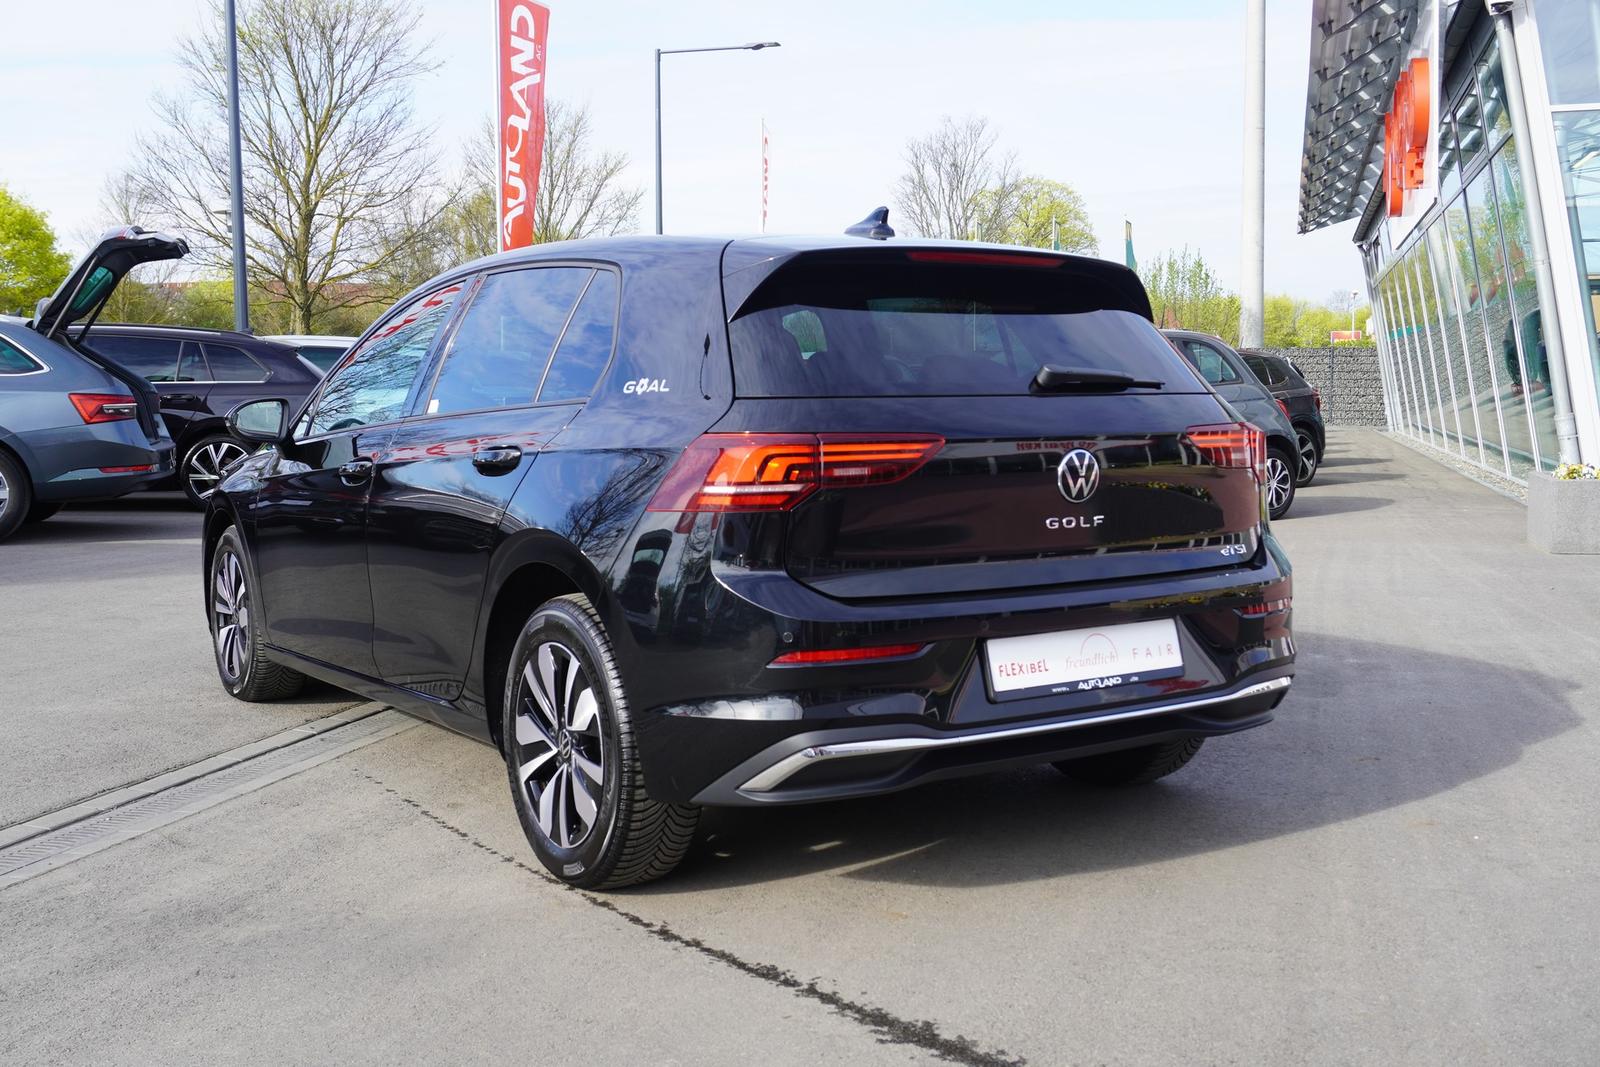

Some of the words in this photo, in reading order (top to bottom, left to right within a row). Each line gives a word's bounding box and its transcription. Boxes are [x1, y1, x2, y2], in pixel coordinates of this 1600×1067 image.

[503, 4, 541, 247] AUTOLAND
[622, 377, 670, 395] GOAL
[1045, 515, 1105, 529] GOLF
[998, 659, 1049, 677] FLEXIBEL
[1065, 650, 1117, 671] freundlich
[1077, 676, 1122, 691] AUTOLAND
